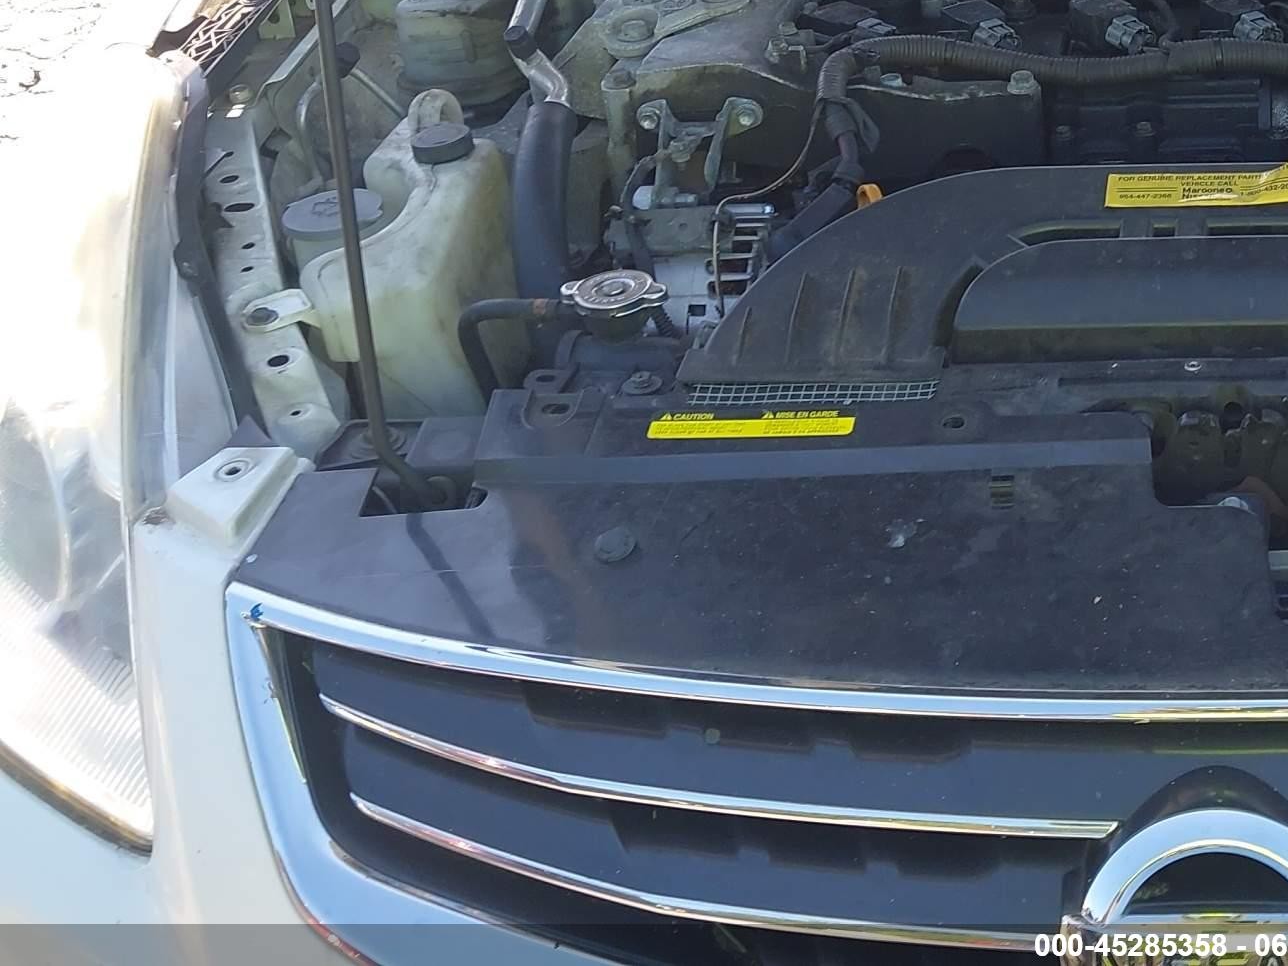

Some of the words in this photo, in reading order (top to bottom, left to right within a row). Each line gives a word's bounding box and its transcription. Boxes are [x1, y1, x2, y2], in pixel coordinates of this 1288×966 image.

[673, 413, 715, 421] CAUTION
[775, 411, 796, 419] MISE
[809, 410, 841, 418] GARDE
